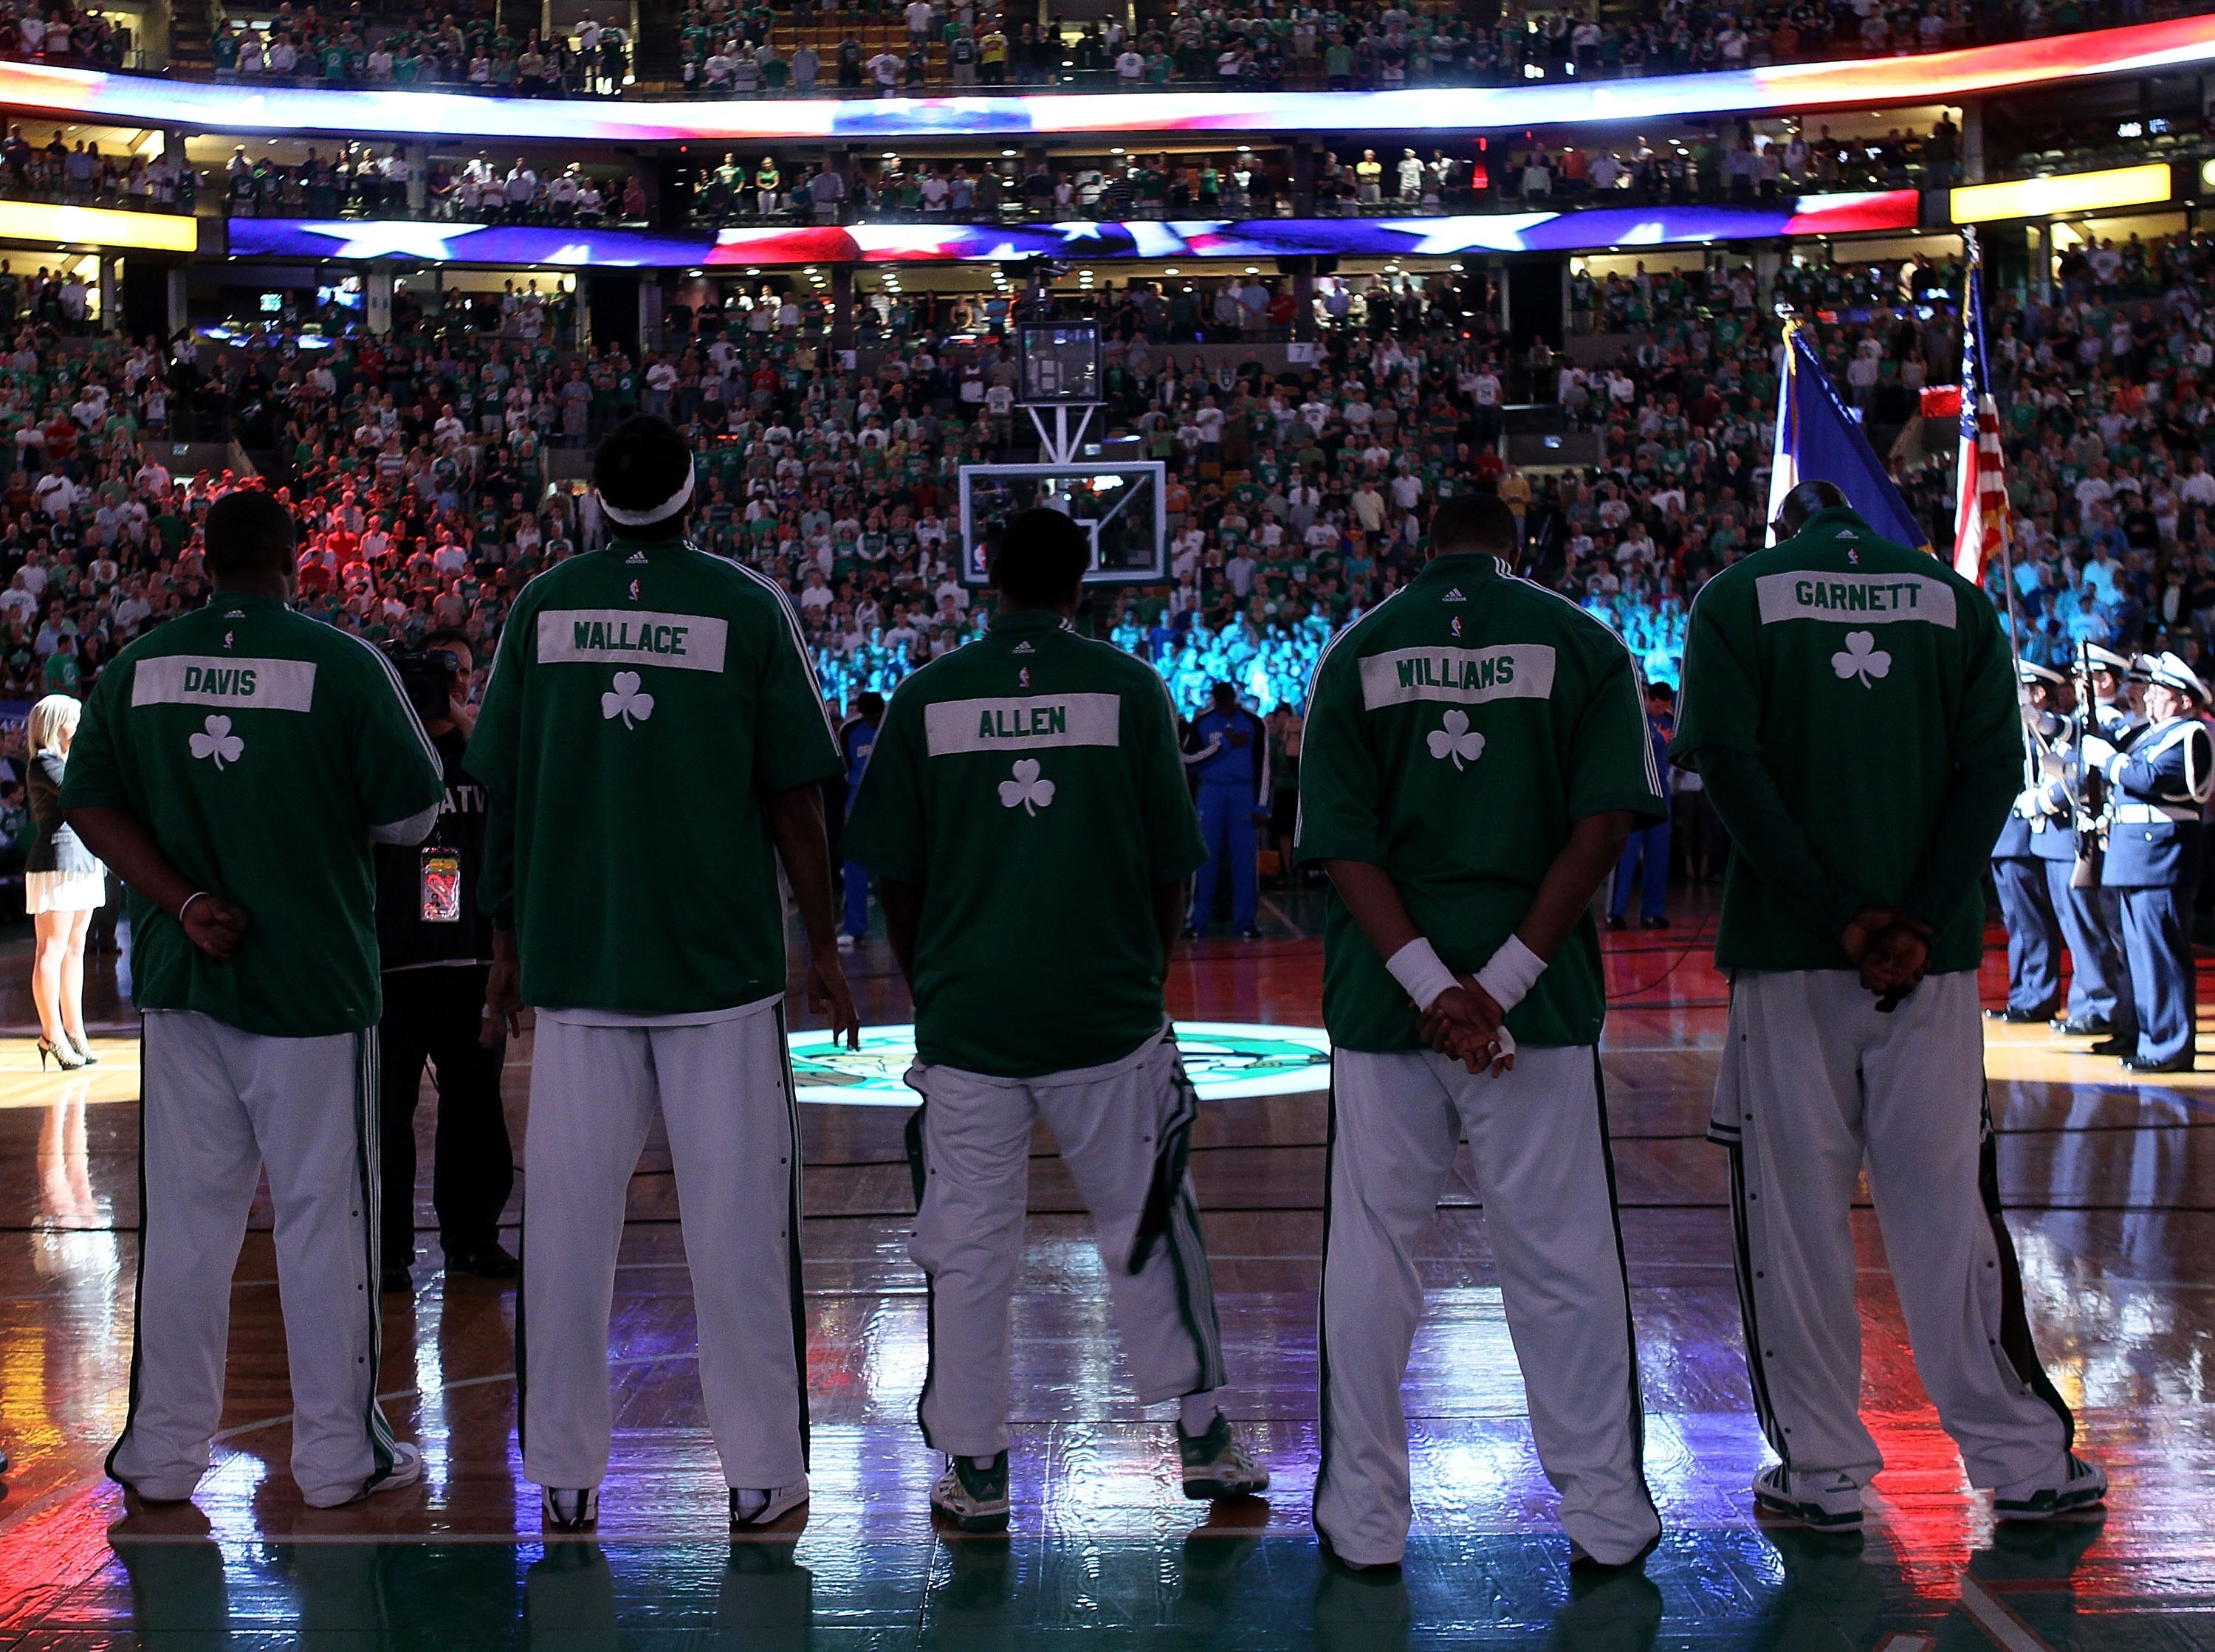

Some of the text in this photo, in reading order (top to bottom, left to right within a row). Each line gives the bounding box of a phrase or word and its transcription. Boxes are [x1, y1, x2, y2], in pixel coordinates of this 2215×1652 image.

[1795, 580, 1922, 611] GARNETT
[574, 621, 689, 655] WALLACE
[184, 667, 257, 696] DAVIS
[1395, 655, 1514, 690] WILLIAMS
[979, 706, 1065, 738] ALLEN
